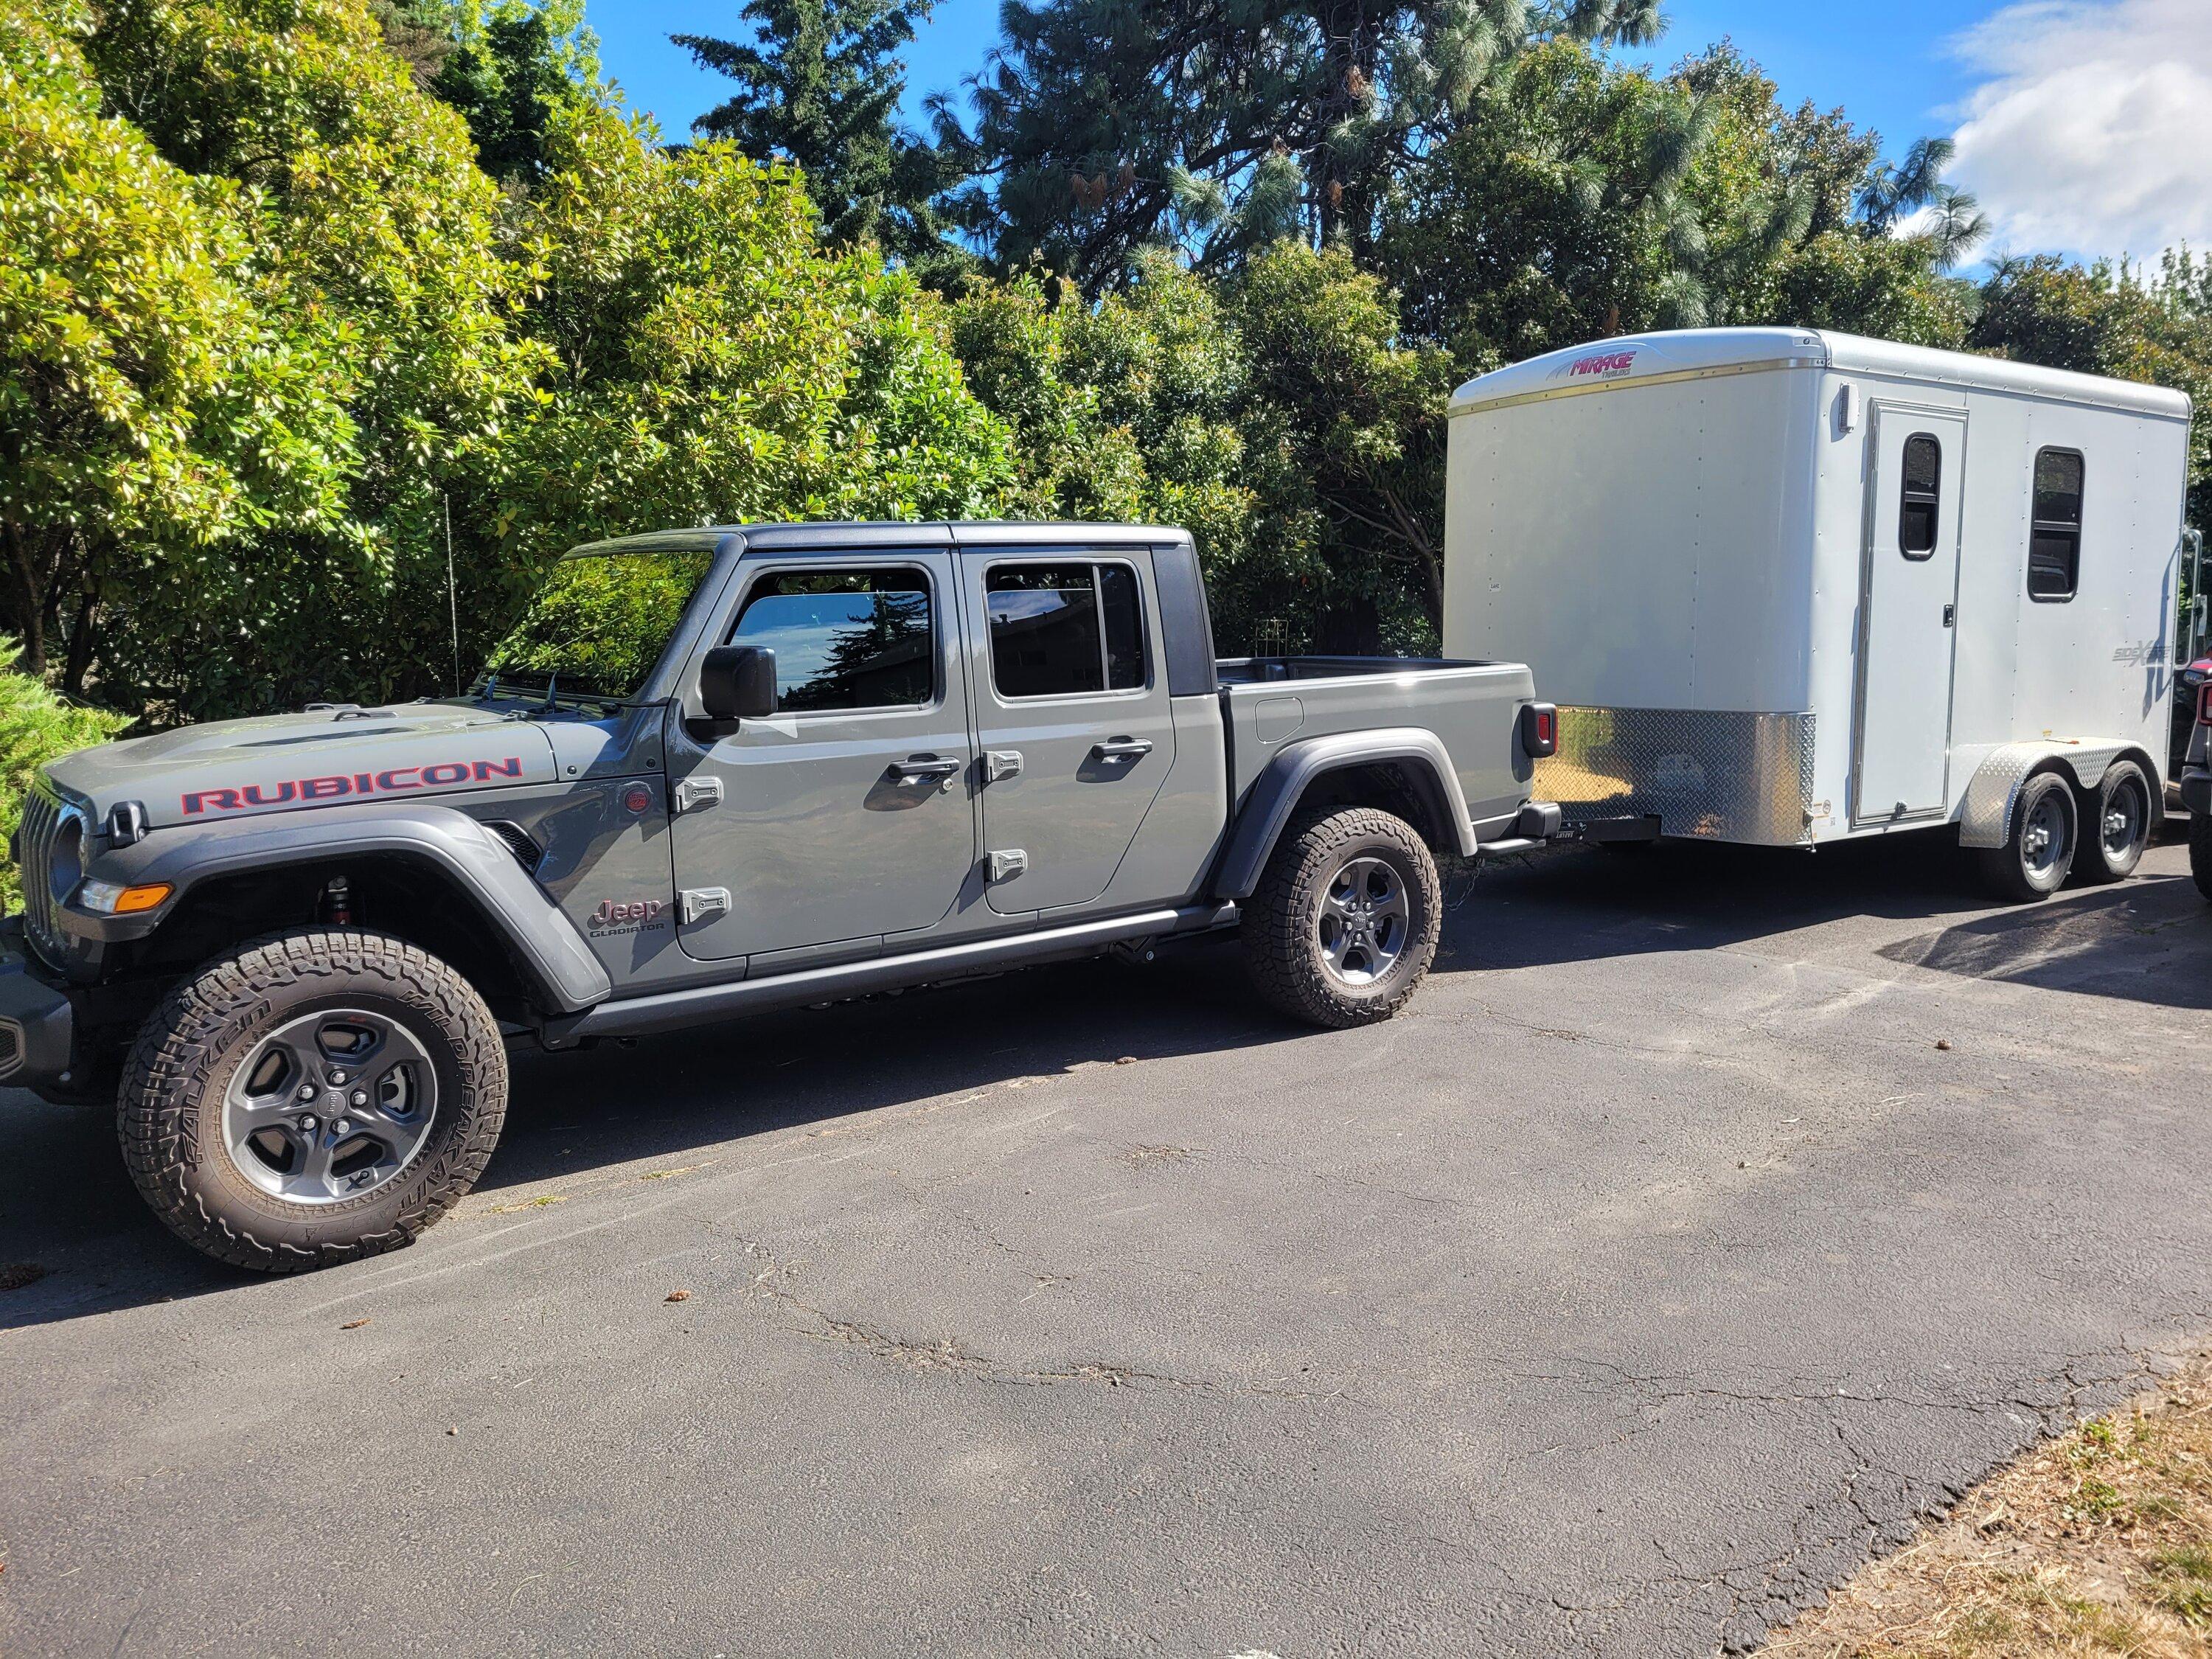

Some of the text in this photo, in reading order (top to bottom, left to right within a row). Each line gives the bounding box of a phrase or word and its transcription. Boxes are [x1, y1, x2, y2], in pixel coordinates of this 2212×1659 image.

[1569, 351, 1636, 377] MIRAGE
[181, 757, 524, 815] RUBICON
[593, 900, 661, 923] Jeep
[589, 923, 665, 938] GLADIATOR
[397, 990, 477, 1160] WILDPEAK
